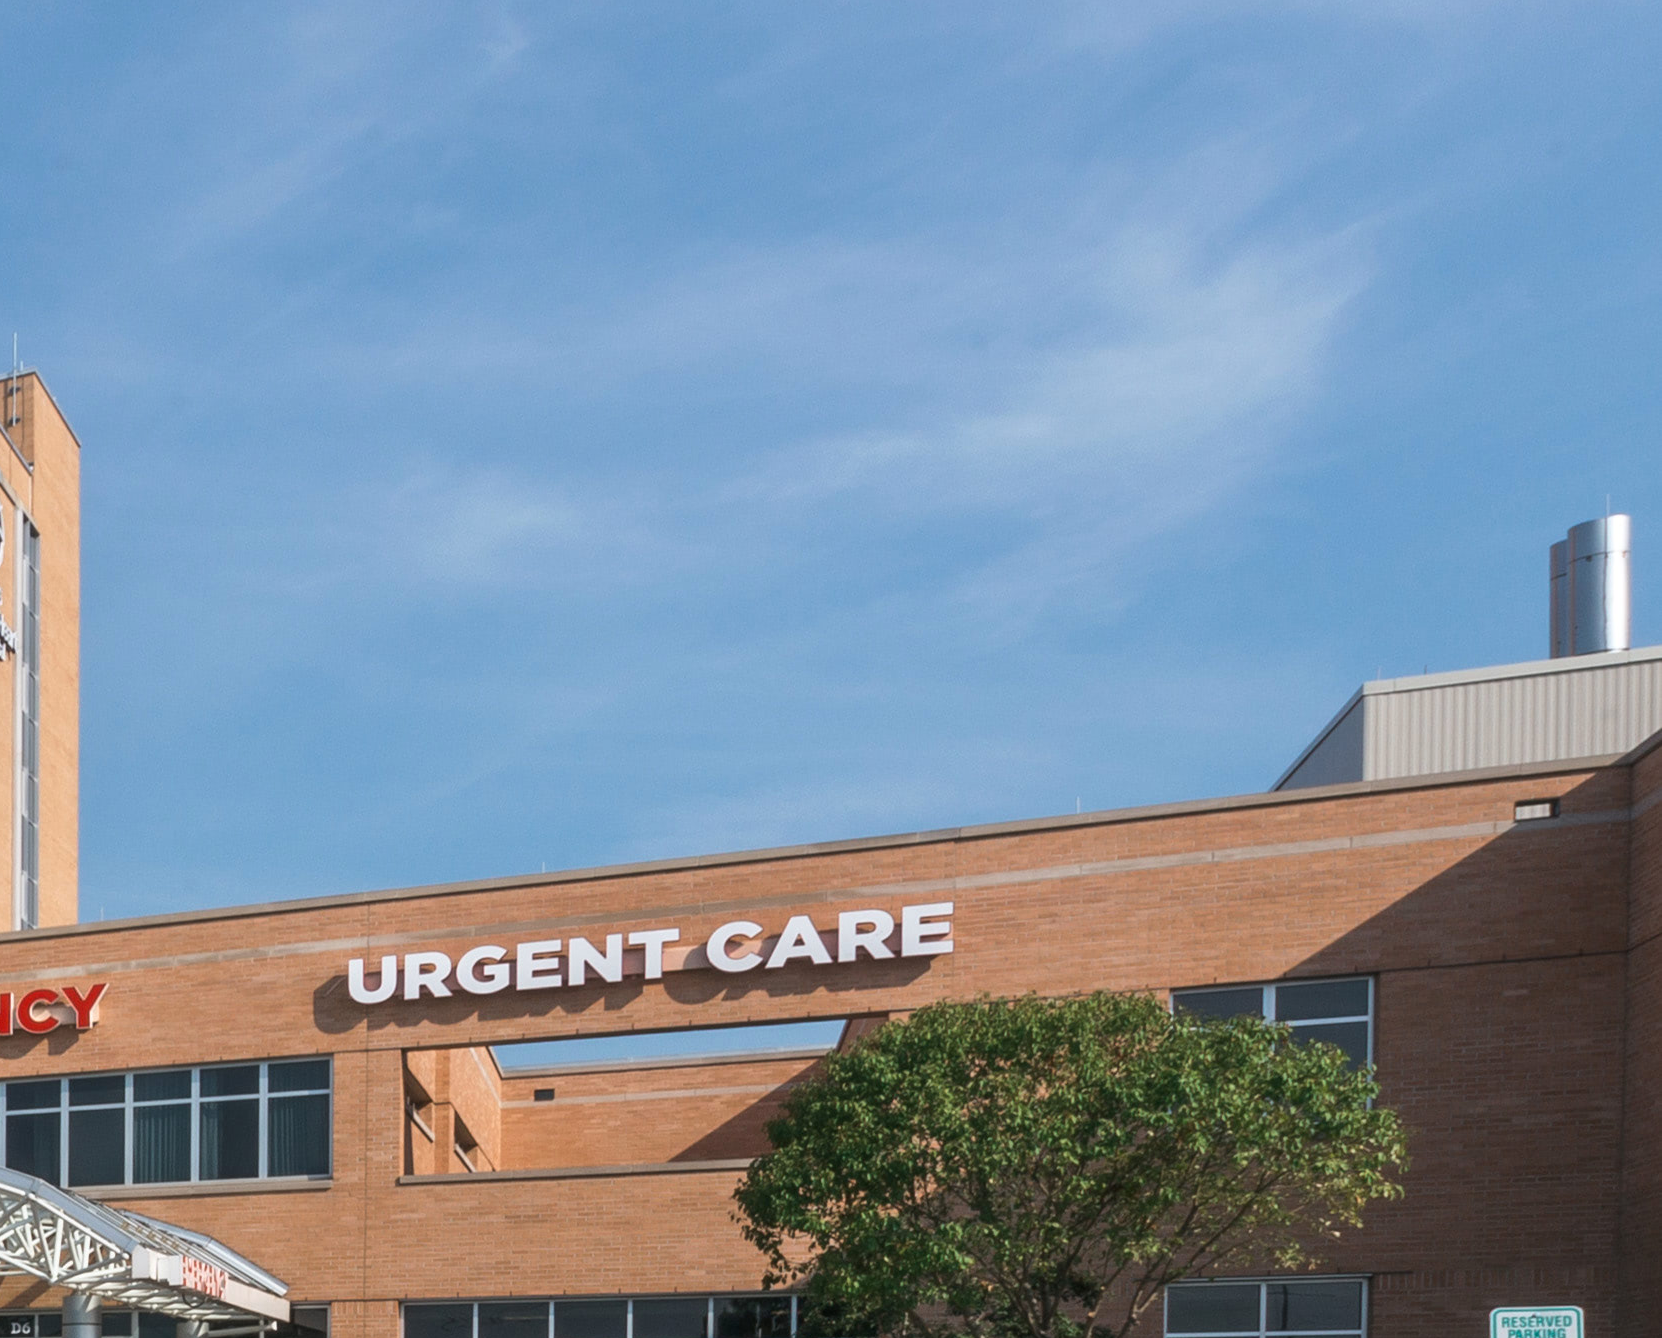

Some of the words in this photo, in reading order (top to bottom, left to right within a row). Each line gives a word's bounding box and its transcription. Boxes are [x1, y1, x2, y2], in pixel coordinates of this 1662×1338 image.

[347, 928, 680, 1005] URGENT
[706, 901, 955, 973] CARE
[11, 1322, 31, 1334] D6
[1501, 1315, 1573, 1328] RESERVED
